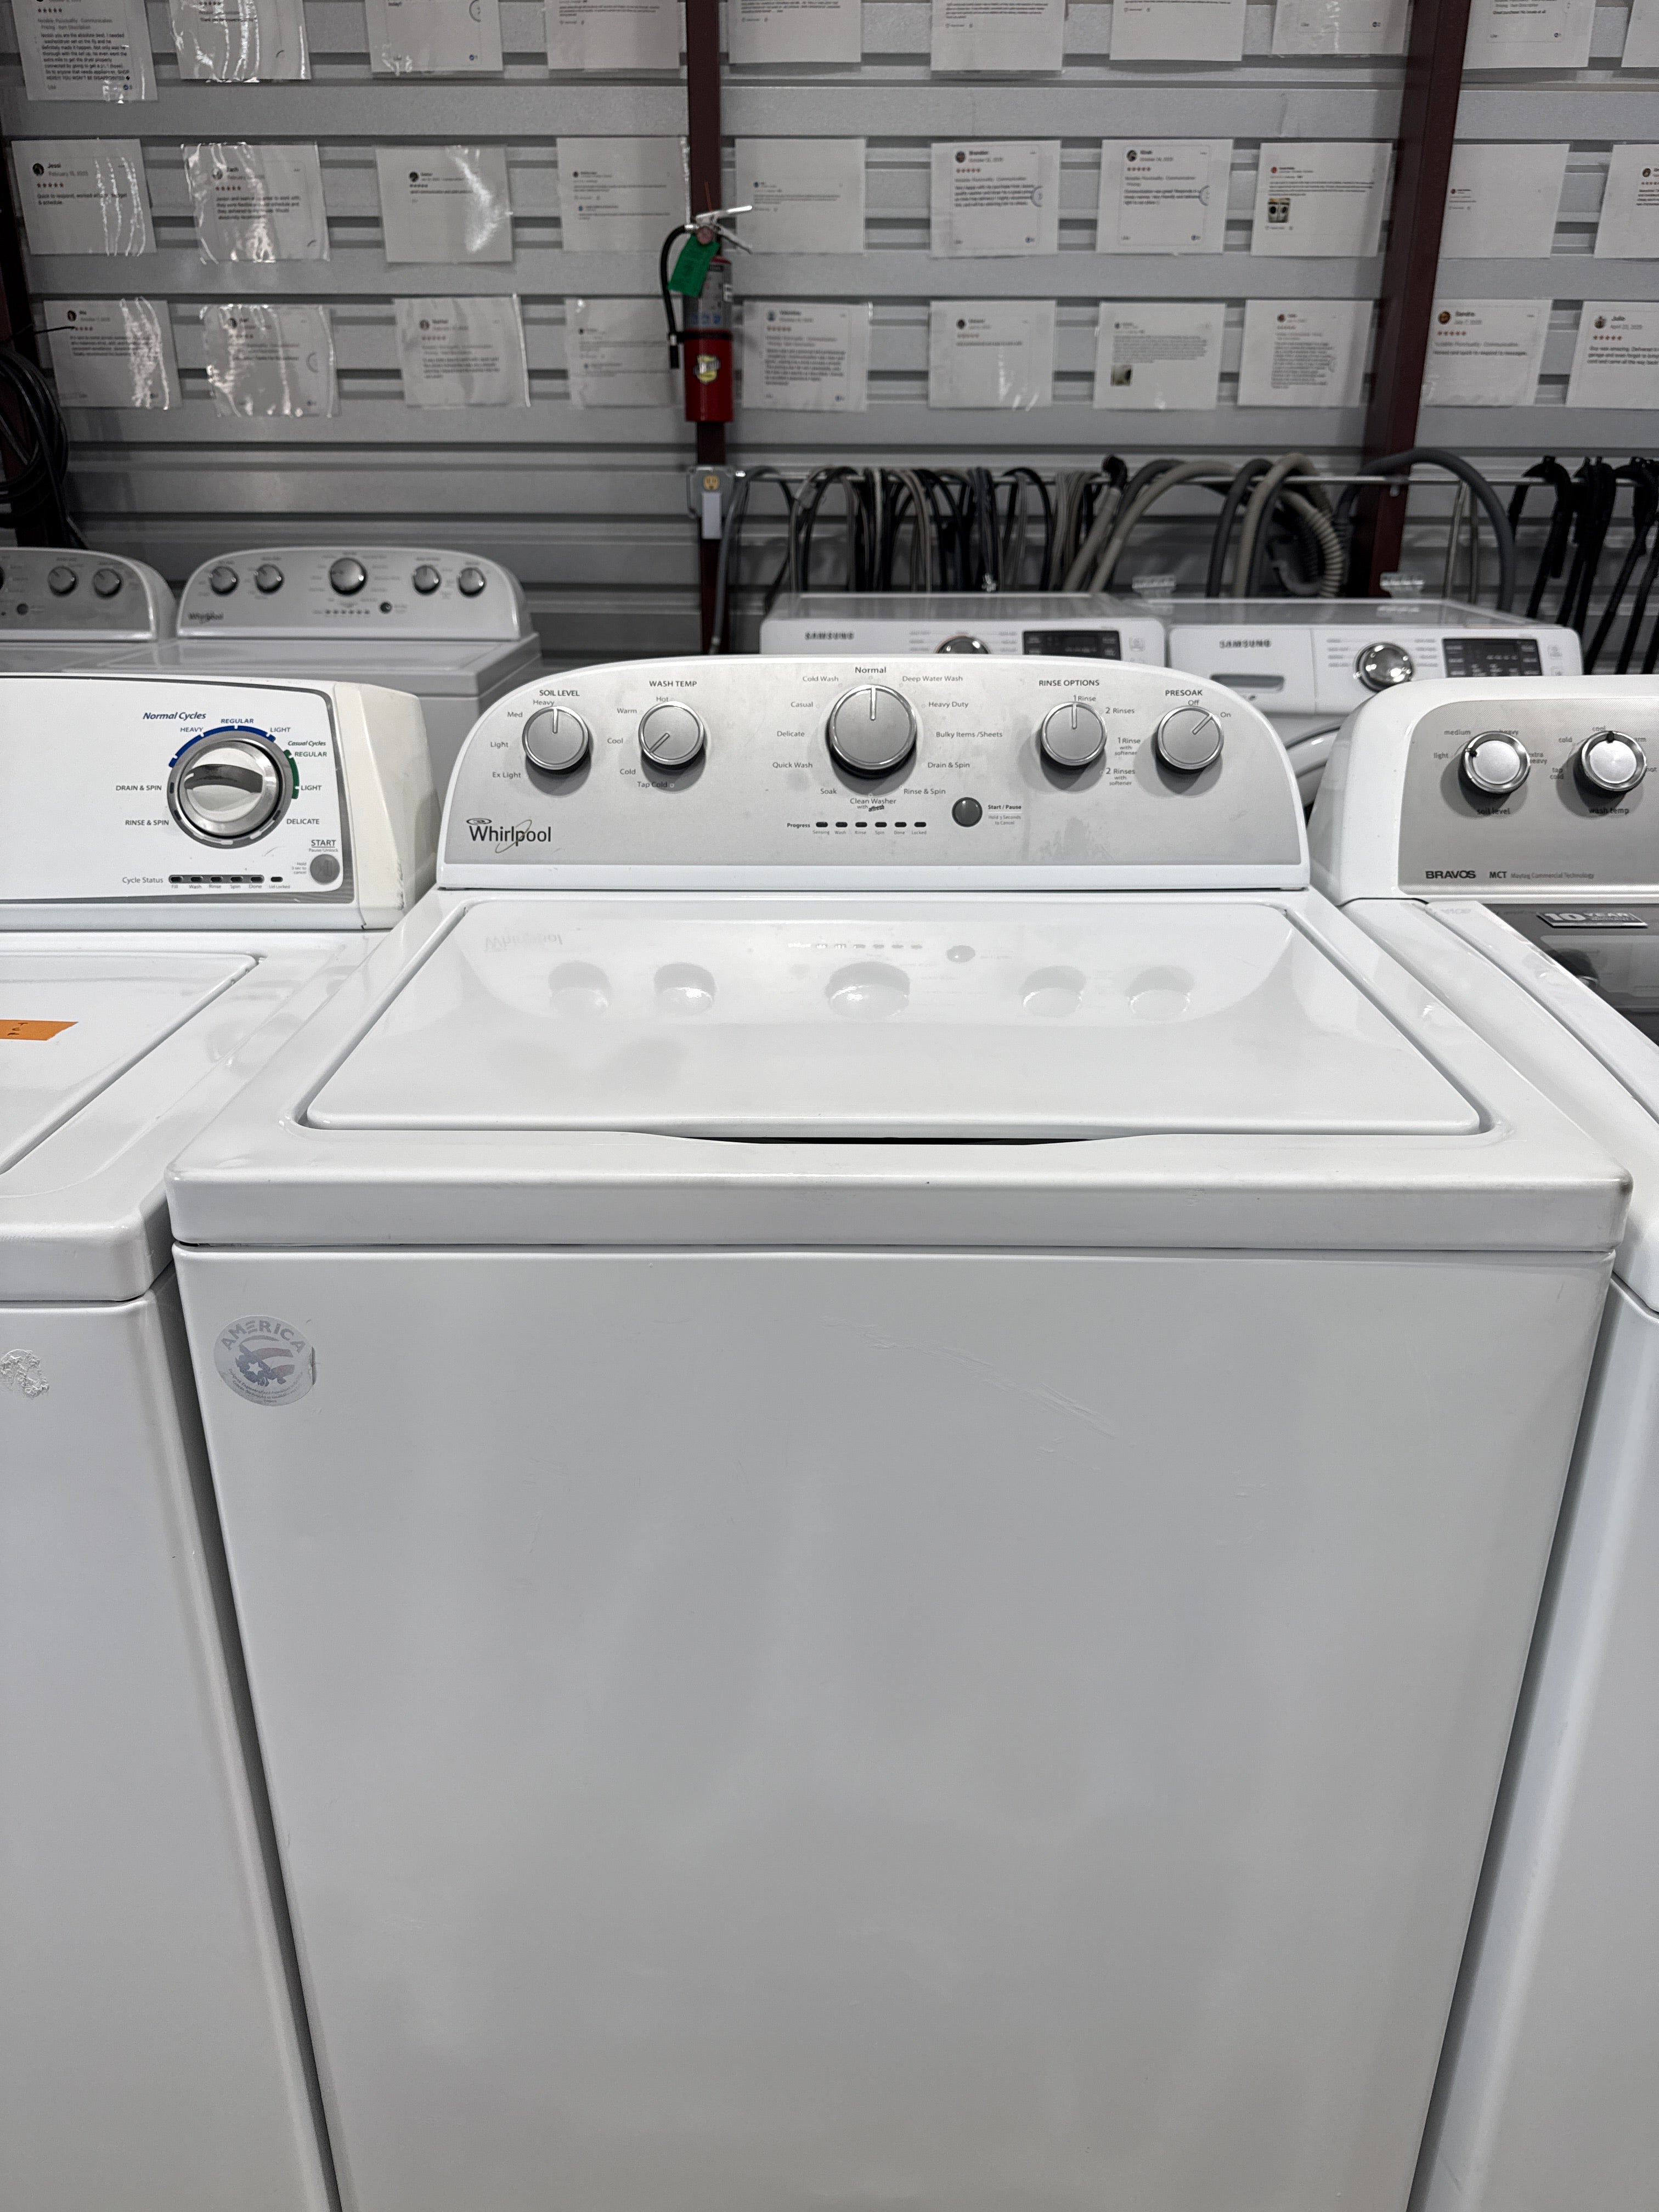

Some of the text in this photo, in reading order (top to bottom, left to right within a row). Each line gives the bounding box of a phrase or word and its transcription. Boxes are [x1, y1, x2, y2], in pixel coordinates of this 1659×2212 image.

[805, 632, 855, 640] SAMSUNG
[1218, 640, 1272, 648] SAMSUNG
[179, 712, 206, 721] Cycles
[470, 825, 551, 847] Whirlpool
[222, 1320, 306, 1353] AMERICA
